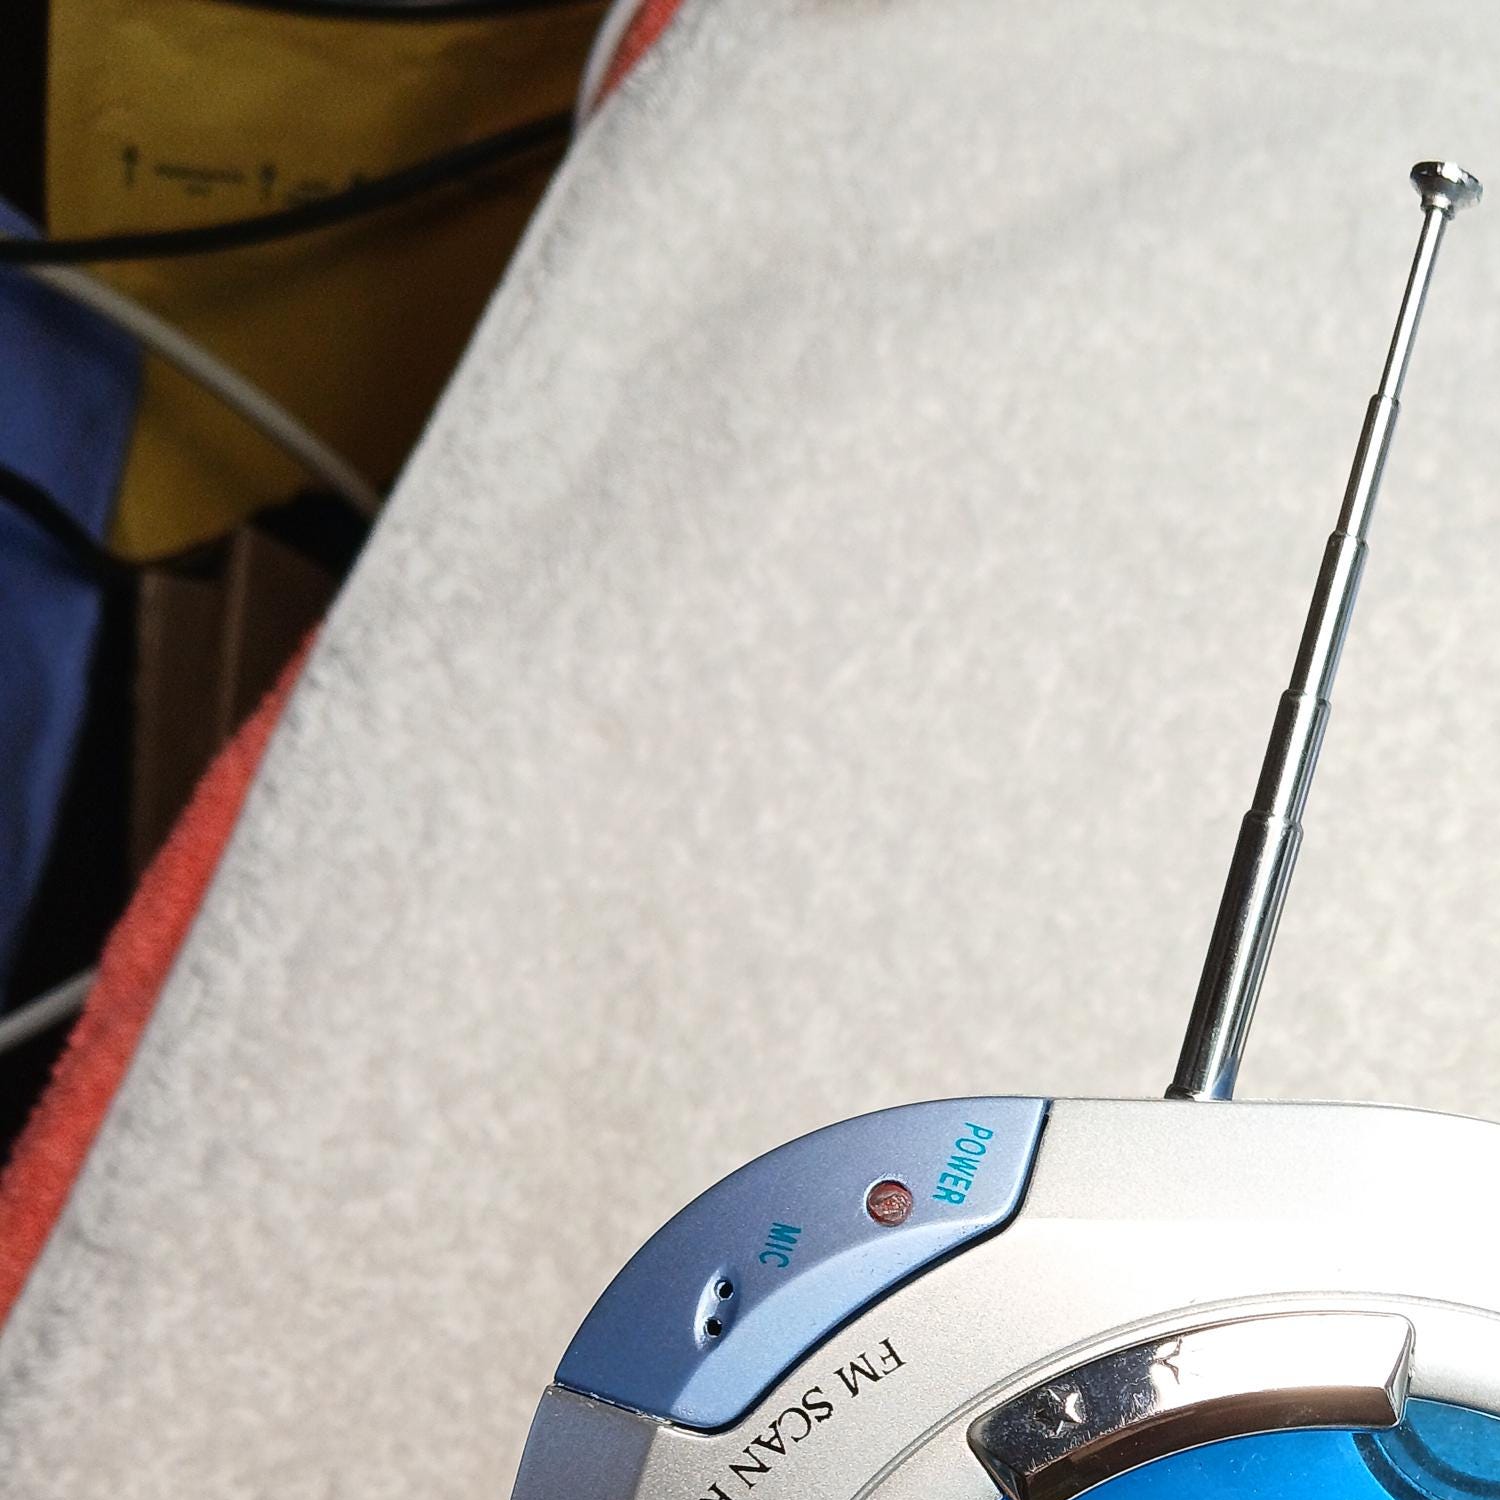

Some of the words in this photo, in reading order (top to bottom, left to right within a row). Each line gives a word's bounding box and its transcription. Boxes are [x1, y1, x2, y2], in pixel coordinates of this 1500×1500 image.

[932, 1121, 994, 1207] POWER
[758, 1221, 802, 1269] MIC
[833, 1336, 907, 1399] FM
[728, 1385, 834, 1490] SCAN
